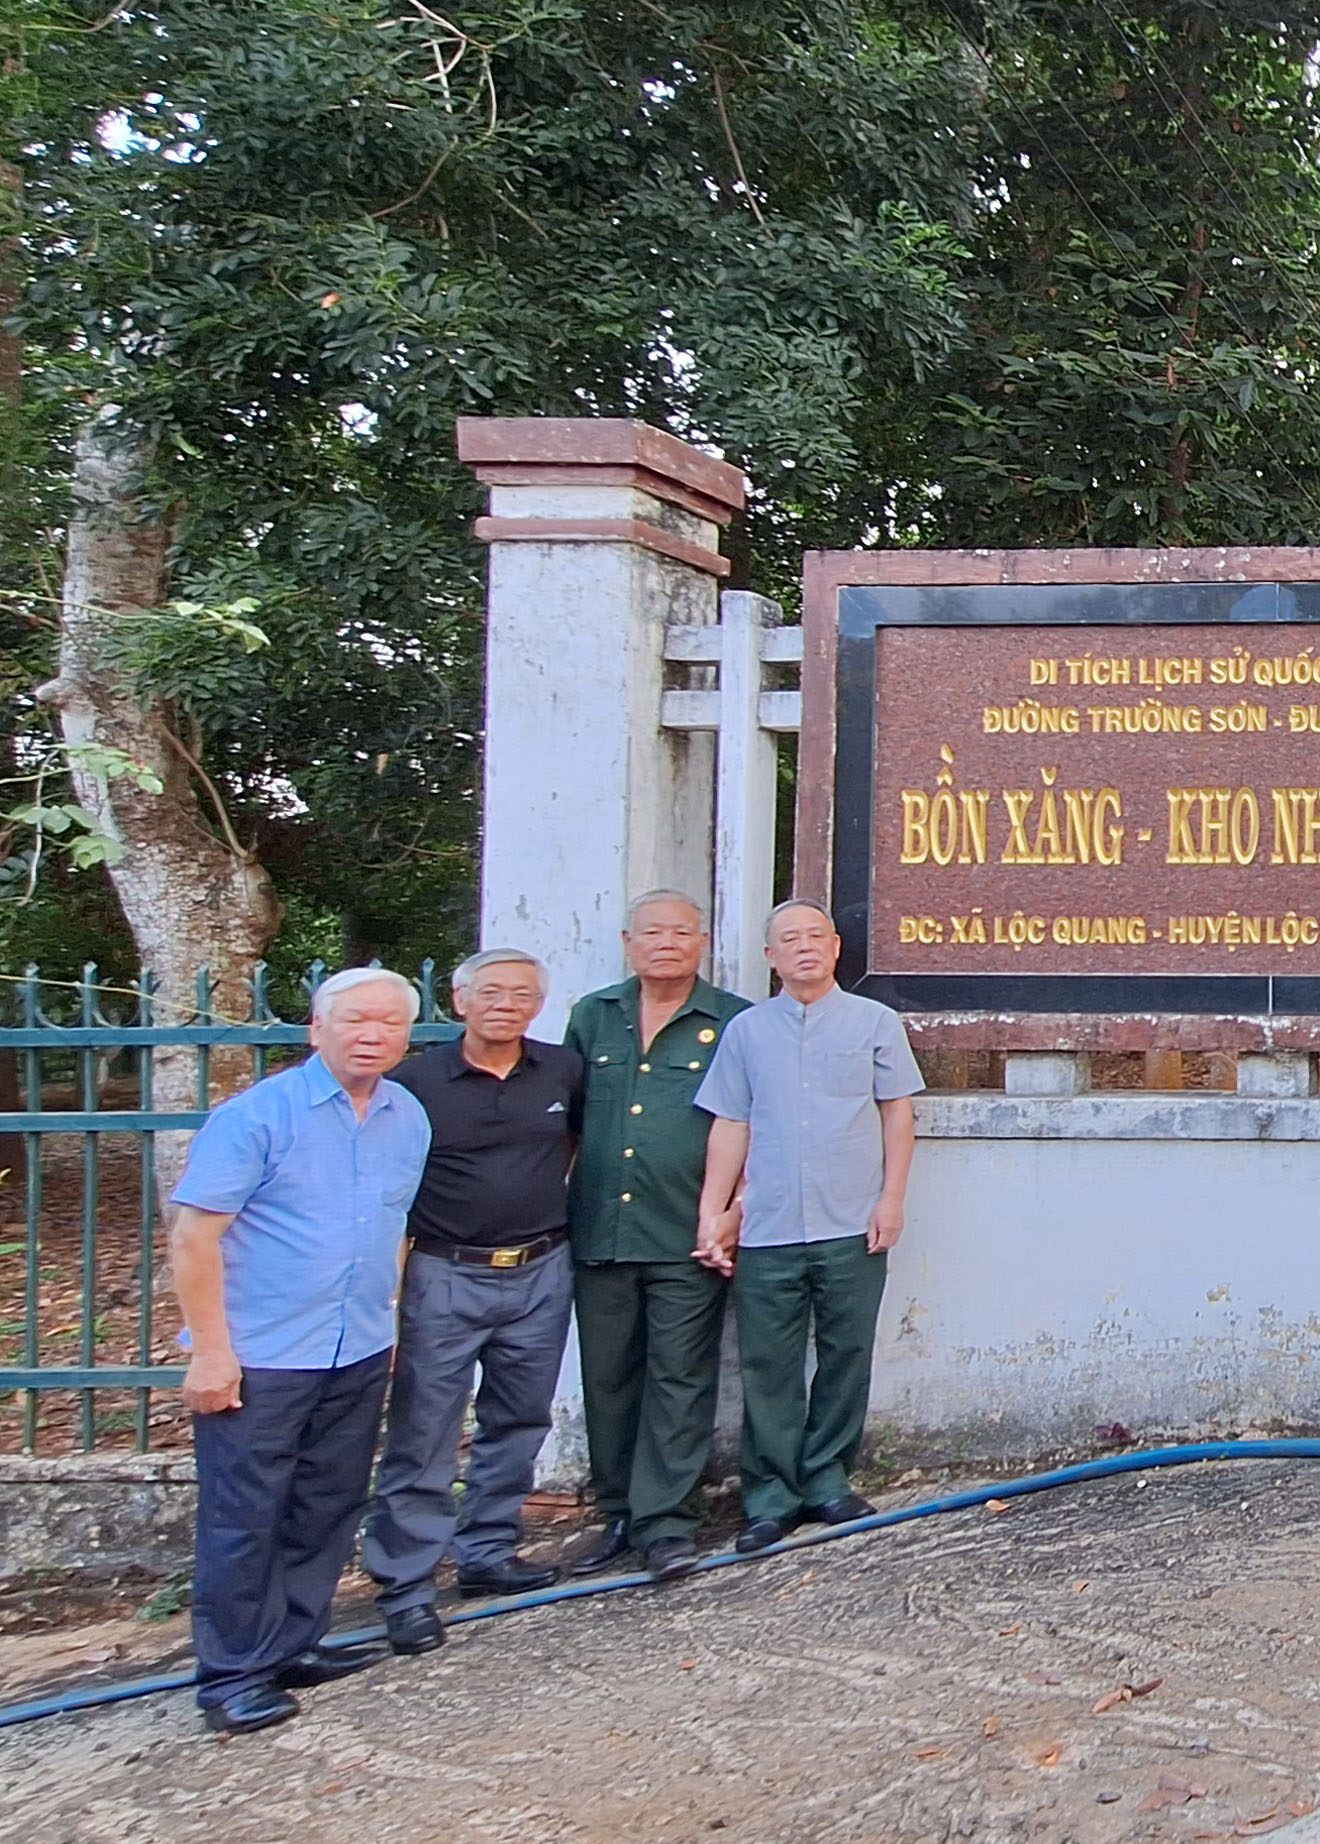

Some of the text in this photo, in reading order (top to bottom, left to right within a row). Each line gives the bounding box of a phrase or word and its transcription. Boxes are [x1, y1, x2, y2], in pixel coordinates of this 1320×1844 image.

[1030, 658, 1058, 685] DI
[1065, 651, 1131, 685] TÍCH
[1139, 658, 1202, 692] LỊCH
[1210, 646, 1251, 685] SỬ
[983, 698, 1080, 733] ĐƯỜNG
[1088, 698, 1202, 733] TRƯỜNG
[1209, 700, 1268, 733] SƠN
[901, 743, 990, 866] BỒN
[1001, 766, 1126, 866] XĂNG
[1137, 826, 1153, 842] -
[1165, 786, 1260, 866] KHO
[900, 916, 944, 944] ĐC:
[950, 907, 987, 944] XÃ
[993, 910, 1046, 951] LỘC
[1052, 915, 1147, 946] QUANG
[1168, 910, 1262, 952] HUYỆN
[1266, 911, 1319, 952] LỘC
